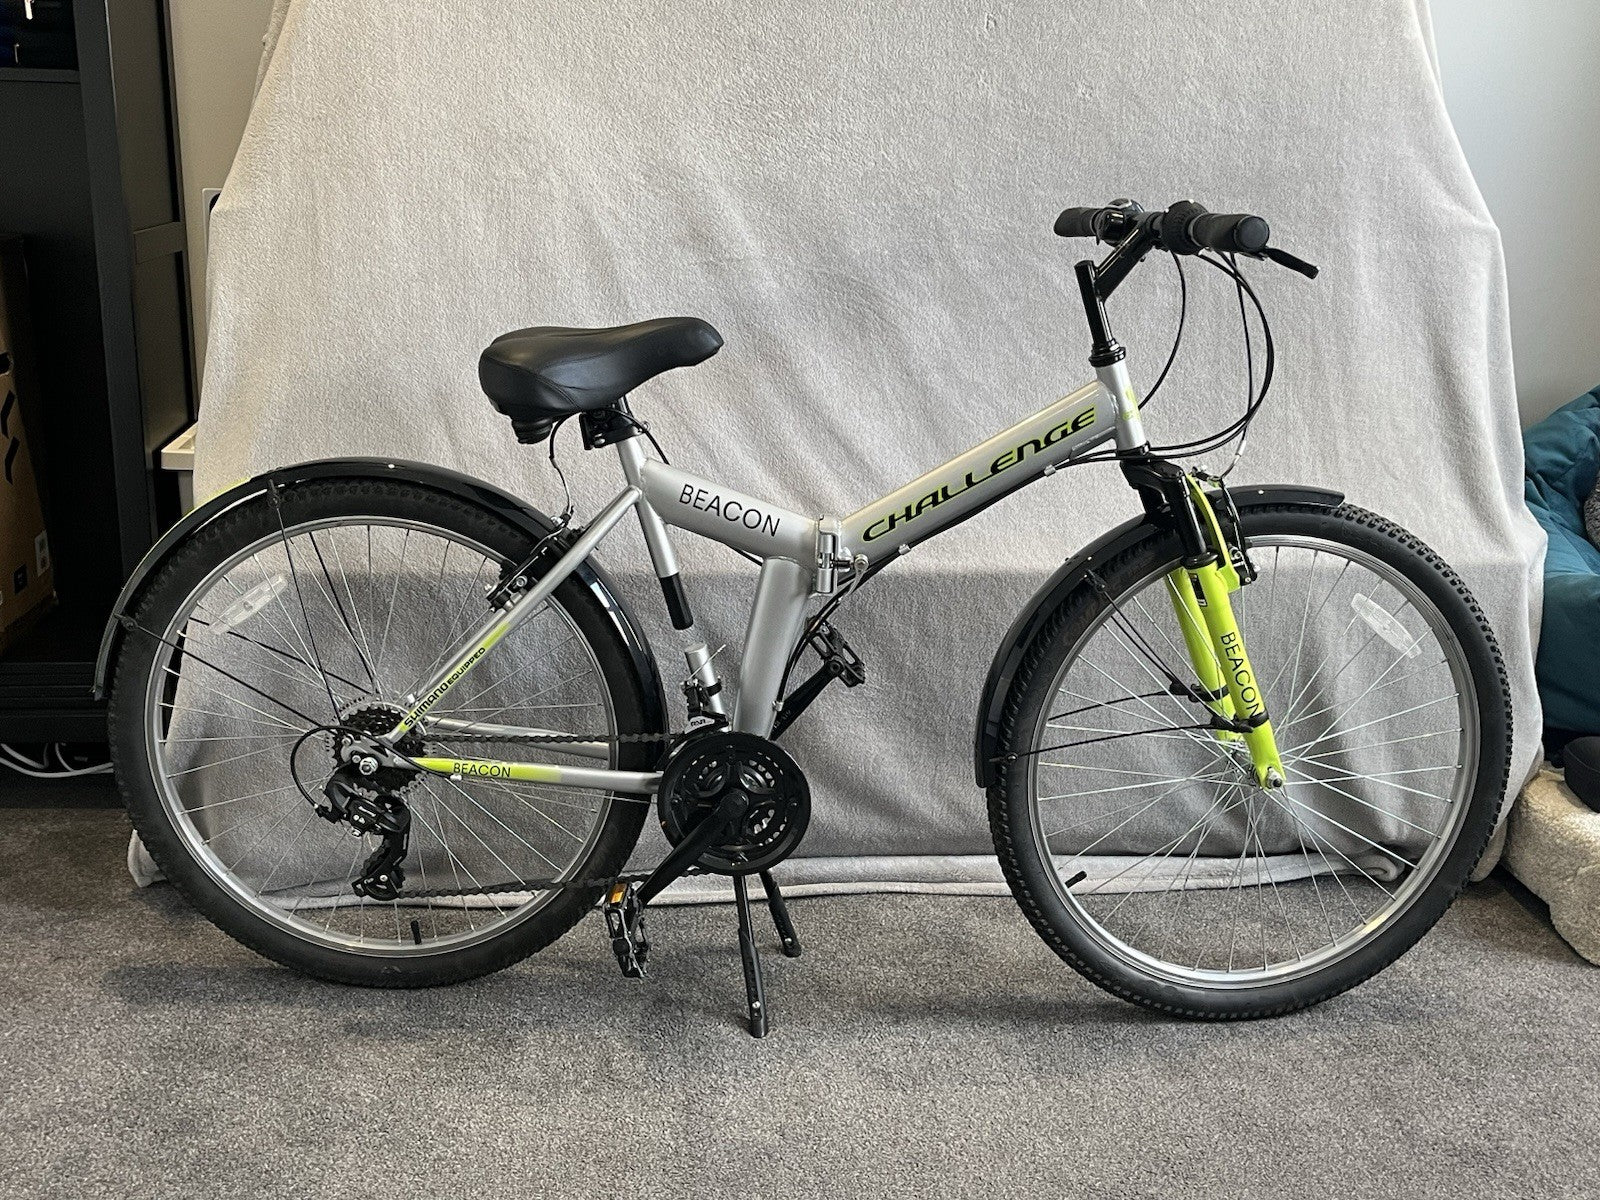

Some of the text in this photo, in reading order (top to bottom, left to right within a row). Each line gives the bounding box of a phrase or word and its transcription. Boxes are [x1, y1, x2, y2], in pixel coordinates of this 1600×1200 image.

[863, 406, 1096, 542] CHALLENGE
[679, 483, 780, 537] BEACON
[404, 647, 486, 727] SHIMANO EQUIPPED
[453, 763, 511, 778] BEACON
